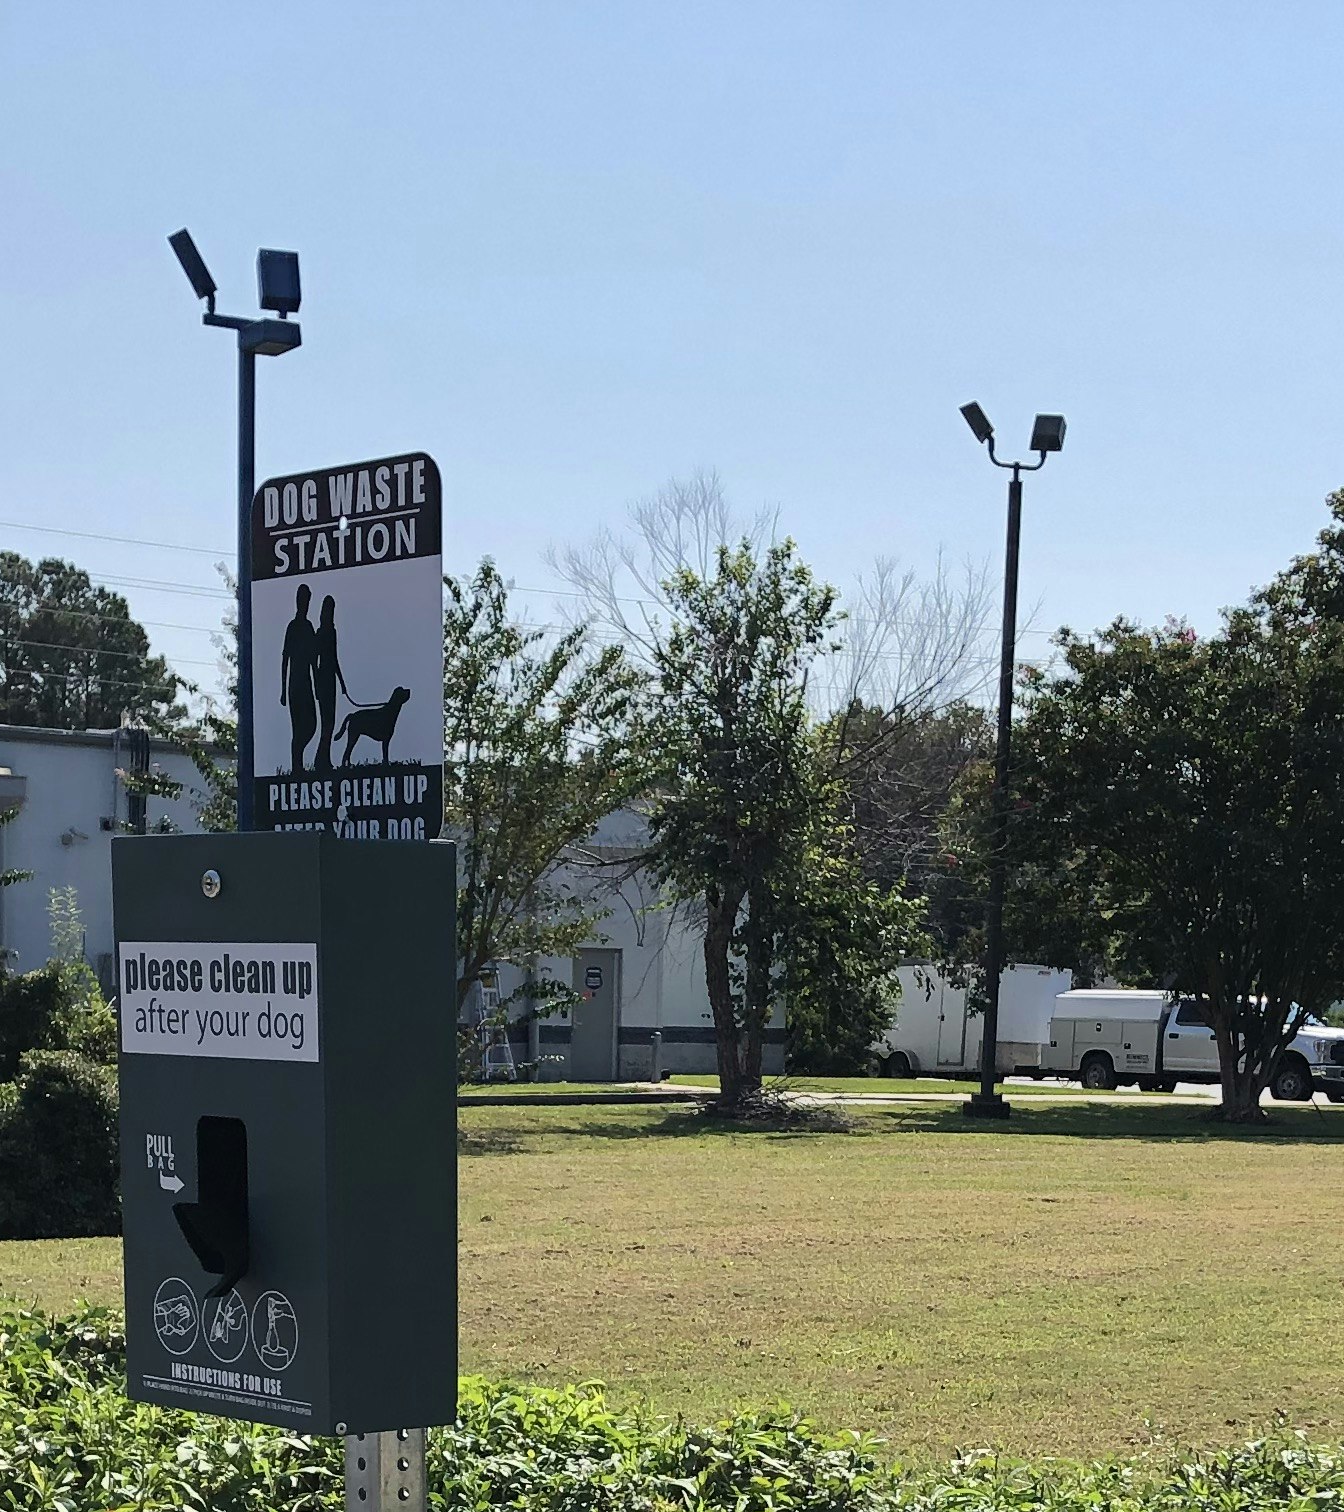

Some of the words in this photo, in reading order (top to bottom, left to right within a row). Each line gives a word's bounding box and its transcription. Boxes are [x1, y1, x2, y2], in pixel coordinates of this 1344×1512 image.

[264, 479, 318, 528] DOG
[328, 460, 425, 517] WASTE
[274, 518, 416, 574] STATION
[269, 780, 333, 811] PLEASE
[340, 776, 396, 807] CLEAN
[403, 774, 428, 804] UP
[387, 817, 425, 840] DOG
[125, 952, 203, 994] please
[209, 953, 276, 994] clean
[282, 960, 312, 999] up
[135, 998, 190, 1034] after
[196, 1010, 250, 1045] your
[257, 1001, 304, 1049] dog
[146, 1133, 175, 1158] PULL
[147, 1154, 175, 1171] BAG
[171, 1361, 241, 1389] INSTRUCTIONS
[243, 1373, 261, 1393] FOR
[263, 1377, 282, 1396] USE
